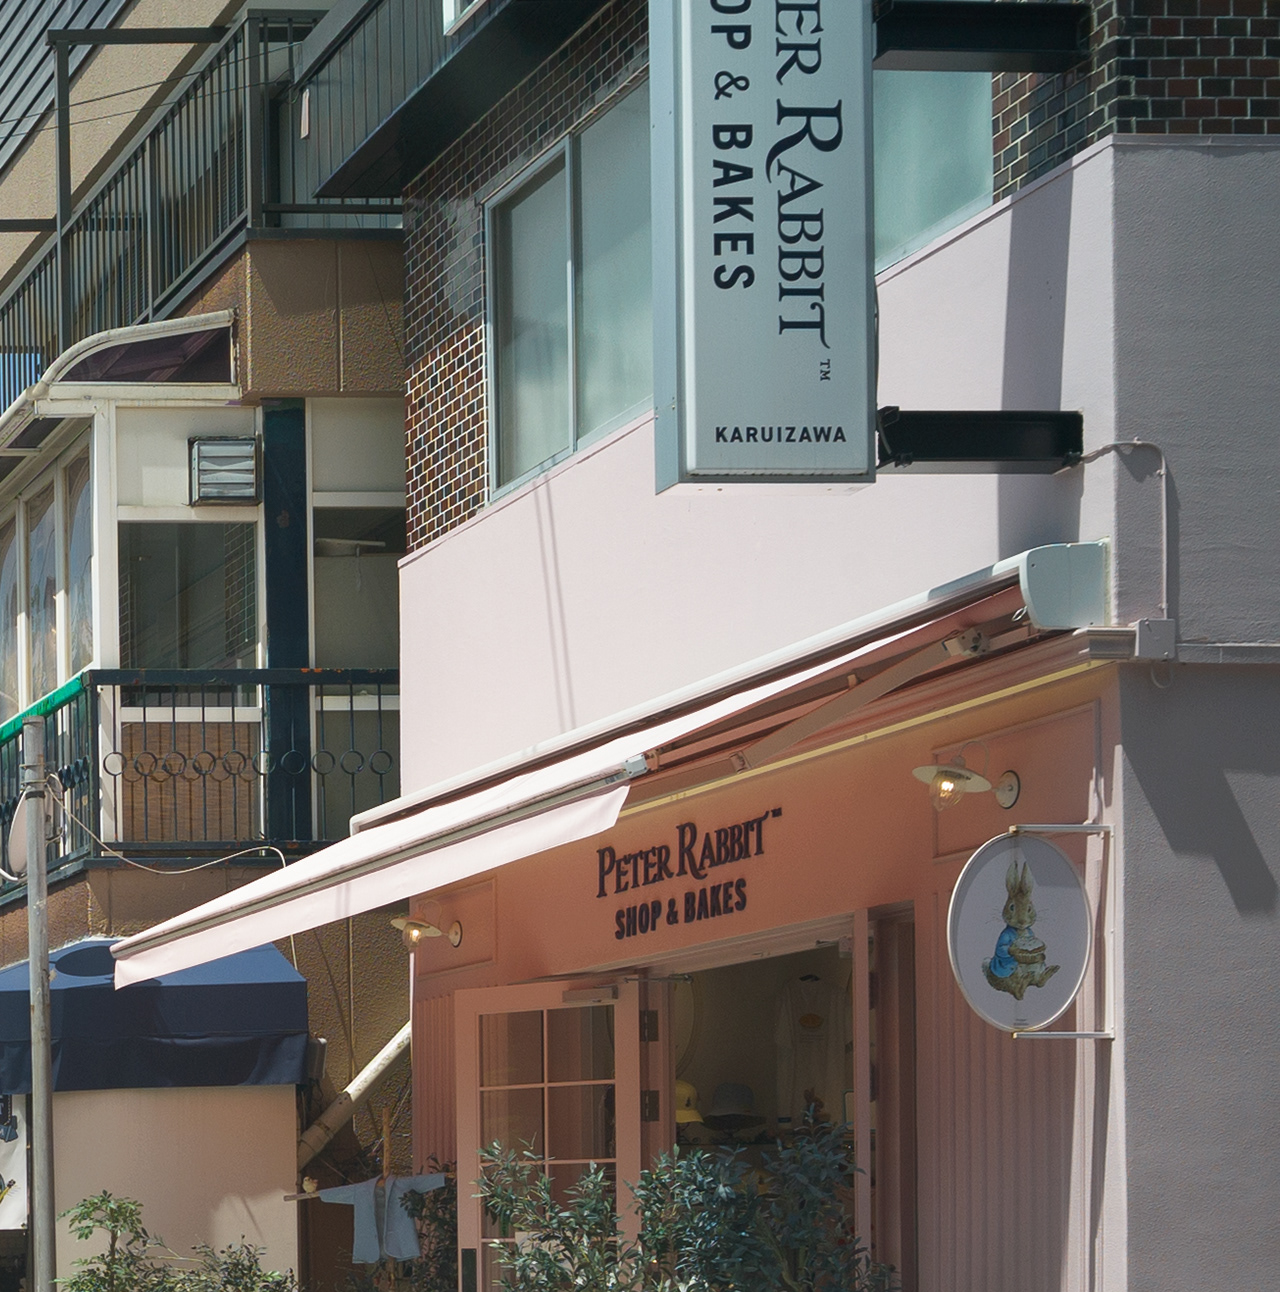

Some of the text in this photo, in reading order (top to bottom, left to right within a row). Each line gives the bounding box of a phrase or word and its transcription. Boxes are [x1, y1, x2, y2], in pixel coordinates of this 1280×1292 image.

[714, 70, 750, 100] &
[712, 124, 755, 290] BAKES
[765, 98, 843, 350] RABBIT
[714, 425, 847, 444] KARUIZAWA
[596, 845, 675, 898] PETER
[676, 810, 770, 881] RABBIT
[614, 878, 747, 940] SHOP & BAKES
